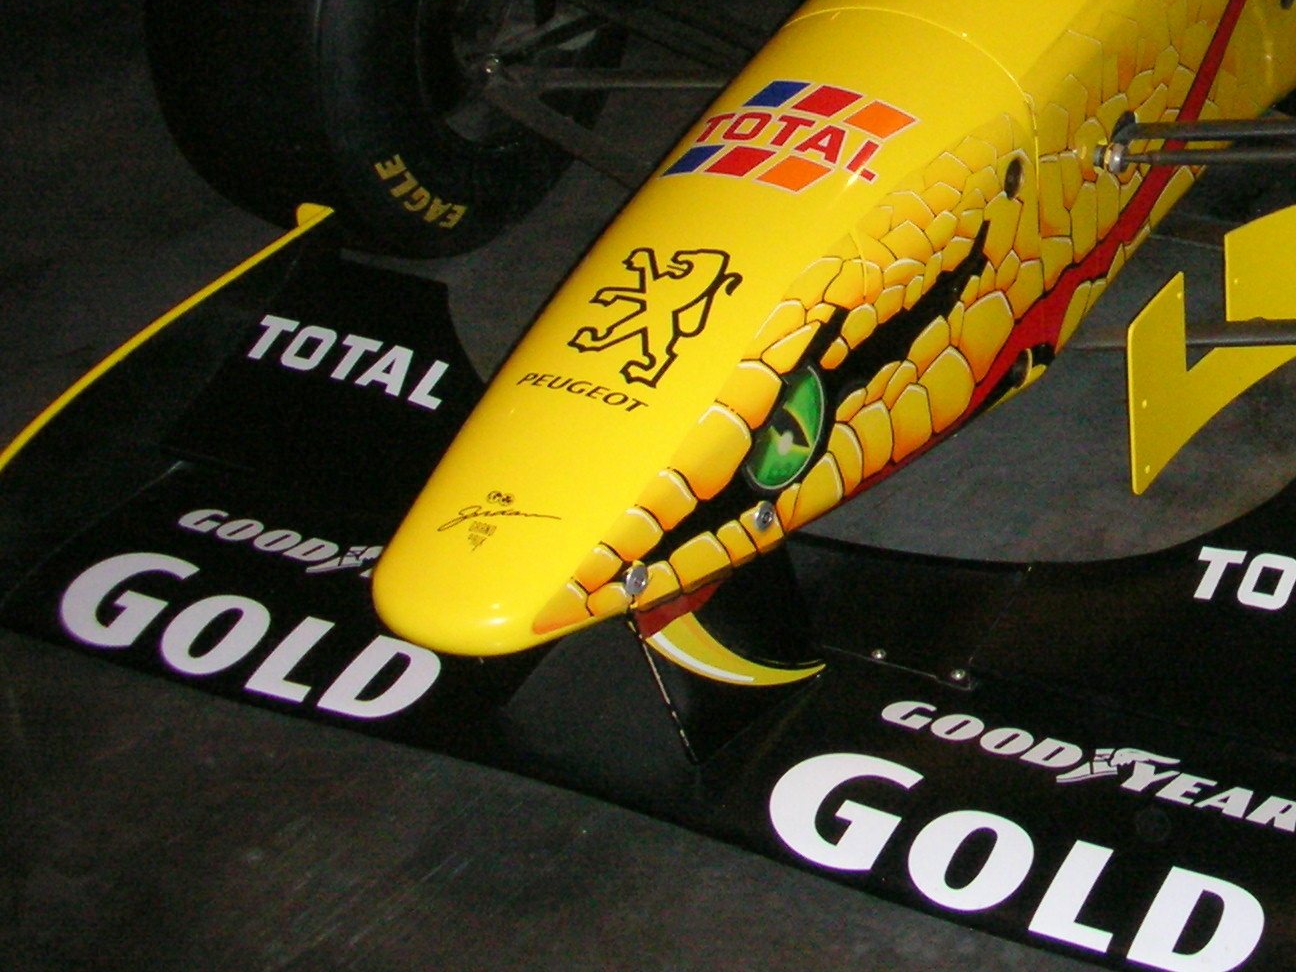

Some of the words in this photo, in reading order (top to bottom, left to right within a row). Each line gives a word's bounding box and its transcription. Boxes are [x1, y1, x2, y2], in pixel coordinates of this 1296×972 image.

[693, 110, 877, 183] TOTAL
[374, 153, 468, 229] EAGLE
[246, 315, 450, 411] TOTAL
[516, 372, 649, 413] PEUGEOT
[59, 551, 442, 720] GOLD
[769, 752, 1266, 972] GOLD
